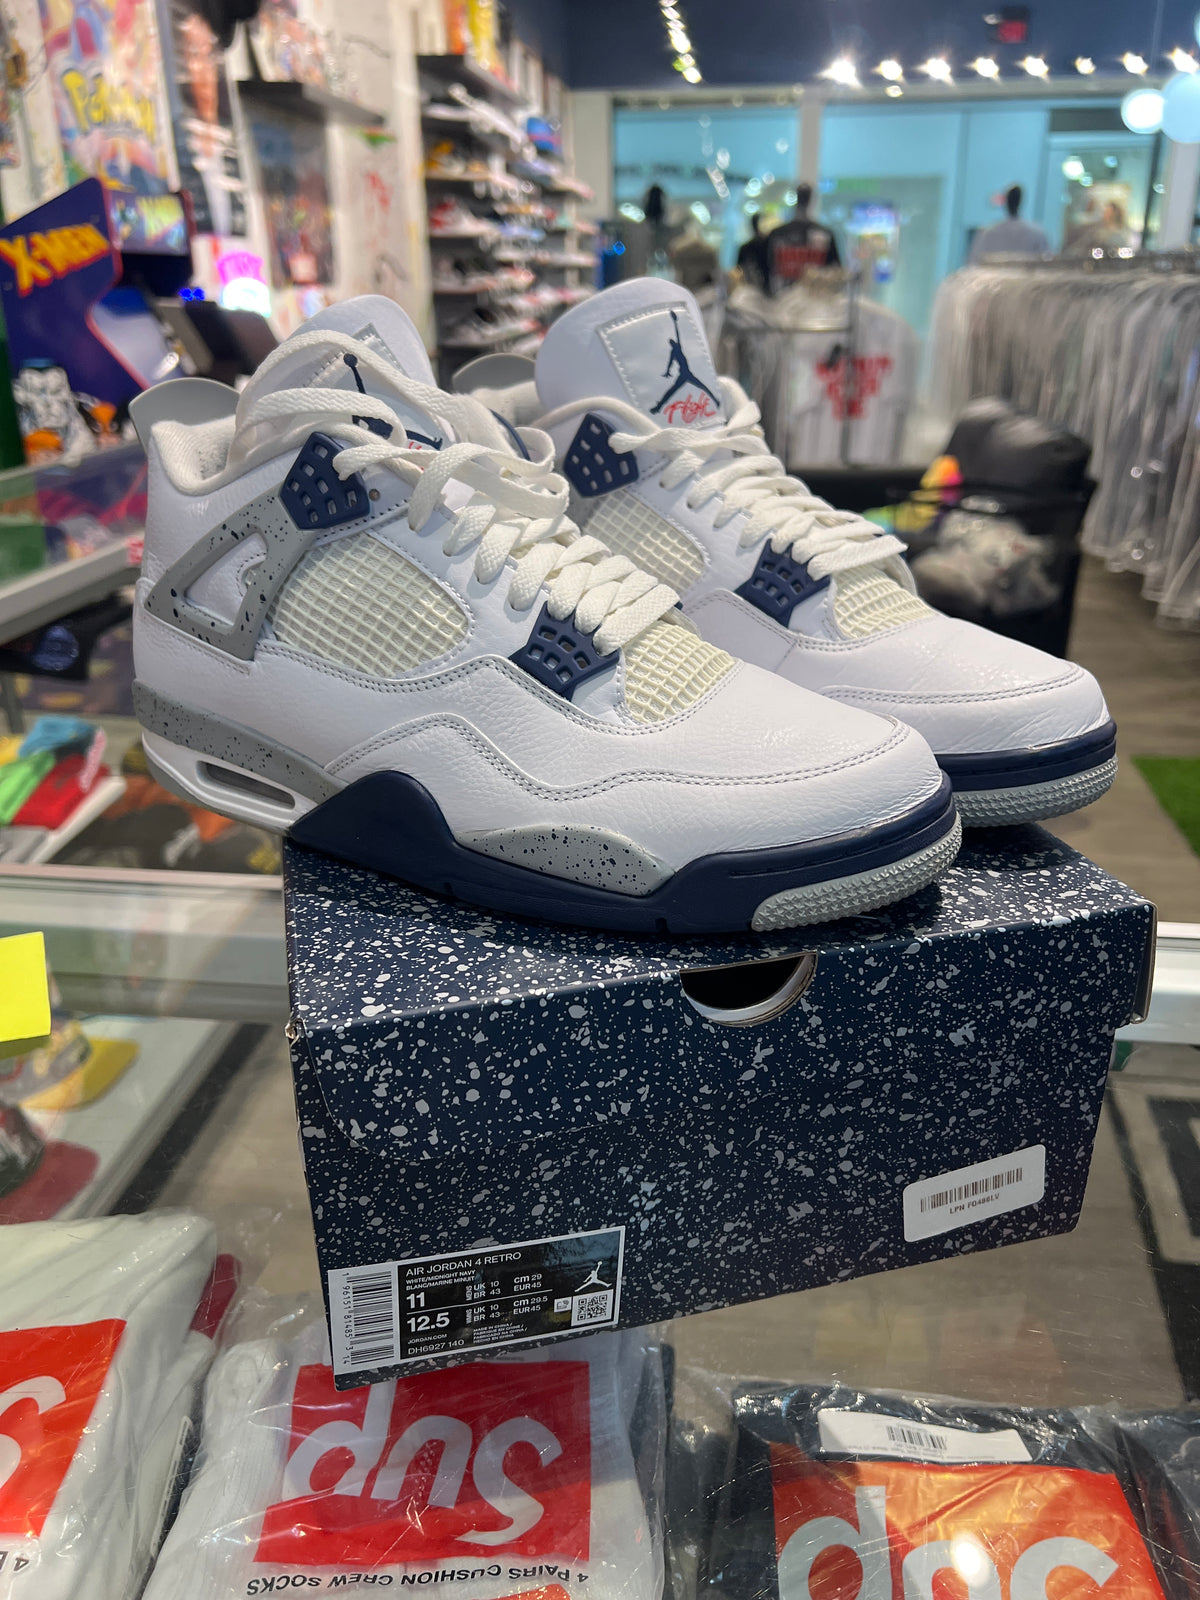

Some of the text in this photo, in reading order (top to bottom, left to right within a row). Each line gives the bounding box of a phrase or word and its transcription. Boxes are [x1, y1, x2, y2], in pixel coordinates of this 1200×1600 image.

[949, 1205, 965, 1215] LPN
[406, 1252, 522, 1276] AIR JORDAN 4 RETRO
[406, 1272, 458, 1285] WHITE/MIDNIGHT
[406, 1276, 475, 1291] BLANC/MARINE MINUIT
[514, 1275, 529, 1284] cm
[474, 1282, 486, 1291] UK
[343, 1286, 351, 1310] 96151
[406, 1292, 425, 1309] 11
[513, 1296, 548, 1307] cm 29.5
[474, 1306, 486, 1314] UK
[407, 1312, 450, 1333] 12.5
[474, 1314, 486, 1322] BR
[344, 1315, 352, 1338] 81485
[408, 1334, 447, 1345] JORDAN.COM
[408, 1338, 465, 1355] DH6927 140
[284, 1382, 562, 1546] Sup
[246, 1564, 590, 1596] 4 PAIRS CUSHION CREW SOCKS
